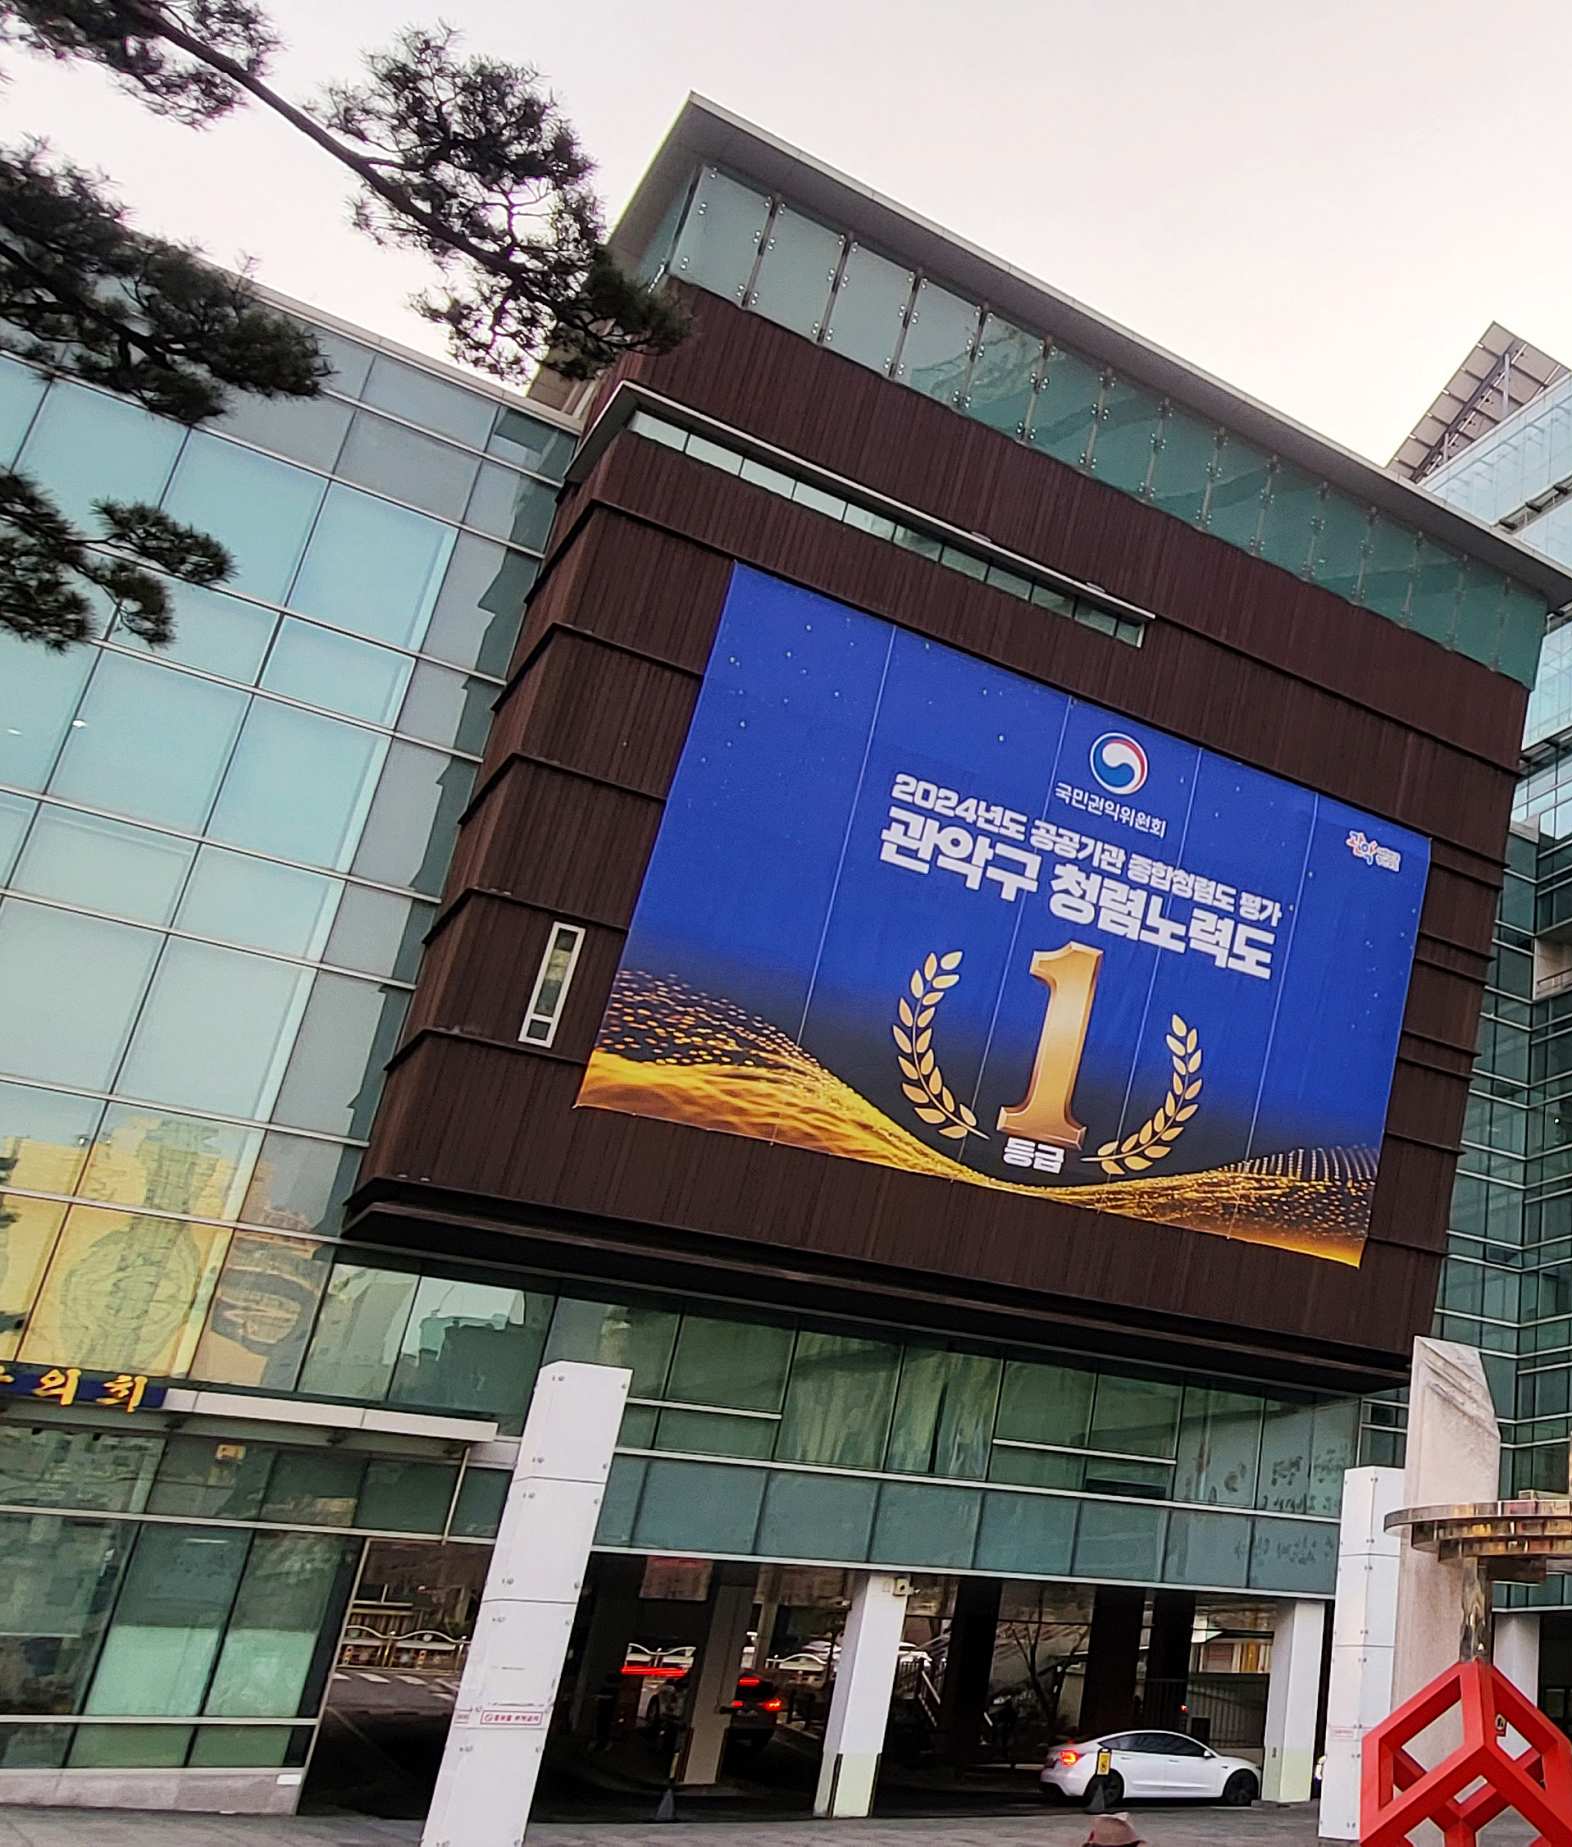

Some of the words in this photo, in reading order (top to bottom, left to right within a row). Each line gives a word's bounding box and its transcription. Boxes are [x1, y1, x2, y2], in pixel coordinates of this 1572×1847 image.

[891, 773, 1029, 841] 2024년도
[1030, 819, 1125, 875] 공공기관
[1127, 852, 1237, 912] 종합청렴도
[1239, 891, 1282, 927] 평가
[1055, 782, 1166, 839] 국민권익위원회
[881, 806, 1042, 902] 관악구
[1050, 863, 1276, 980] 청렴노력도
[997, 941, 1104, 1150] 1
[1003, 1137, 1065, 1174] 등급
